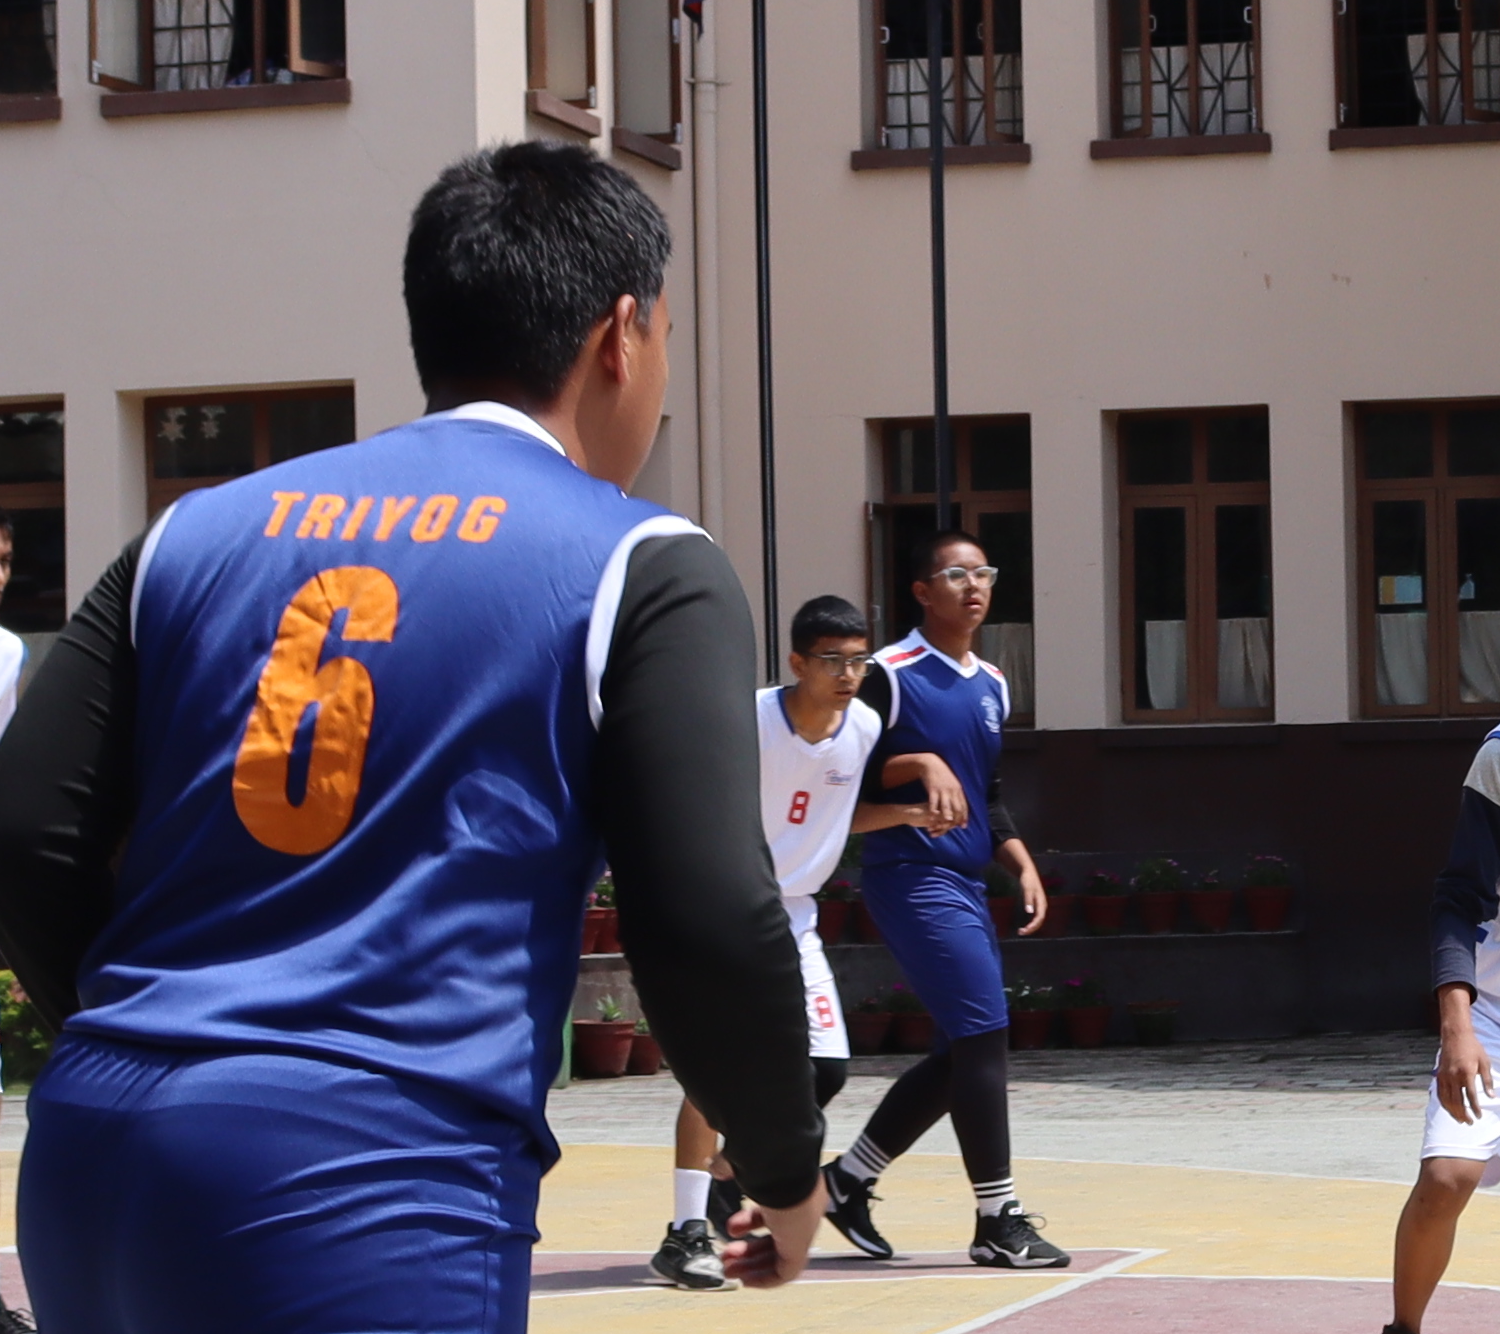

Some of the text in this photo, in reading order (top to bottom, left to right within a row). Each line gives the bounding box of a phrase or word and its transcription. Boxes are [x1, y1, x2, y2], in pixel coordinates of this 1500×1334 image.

[263, 490, 507, 544] TRIYOG
[231, 564, 400, 857] 6
[787, 790, 811, 825] 8
[814, 995, 836, 1028] 8
